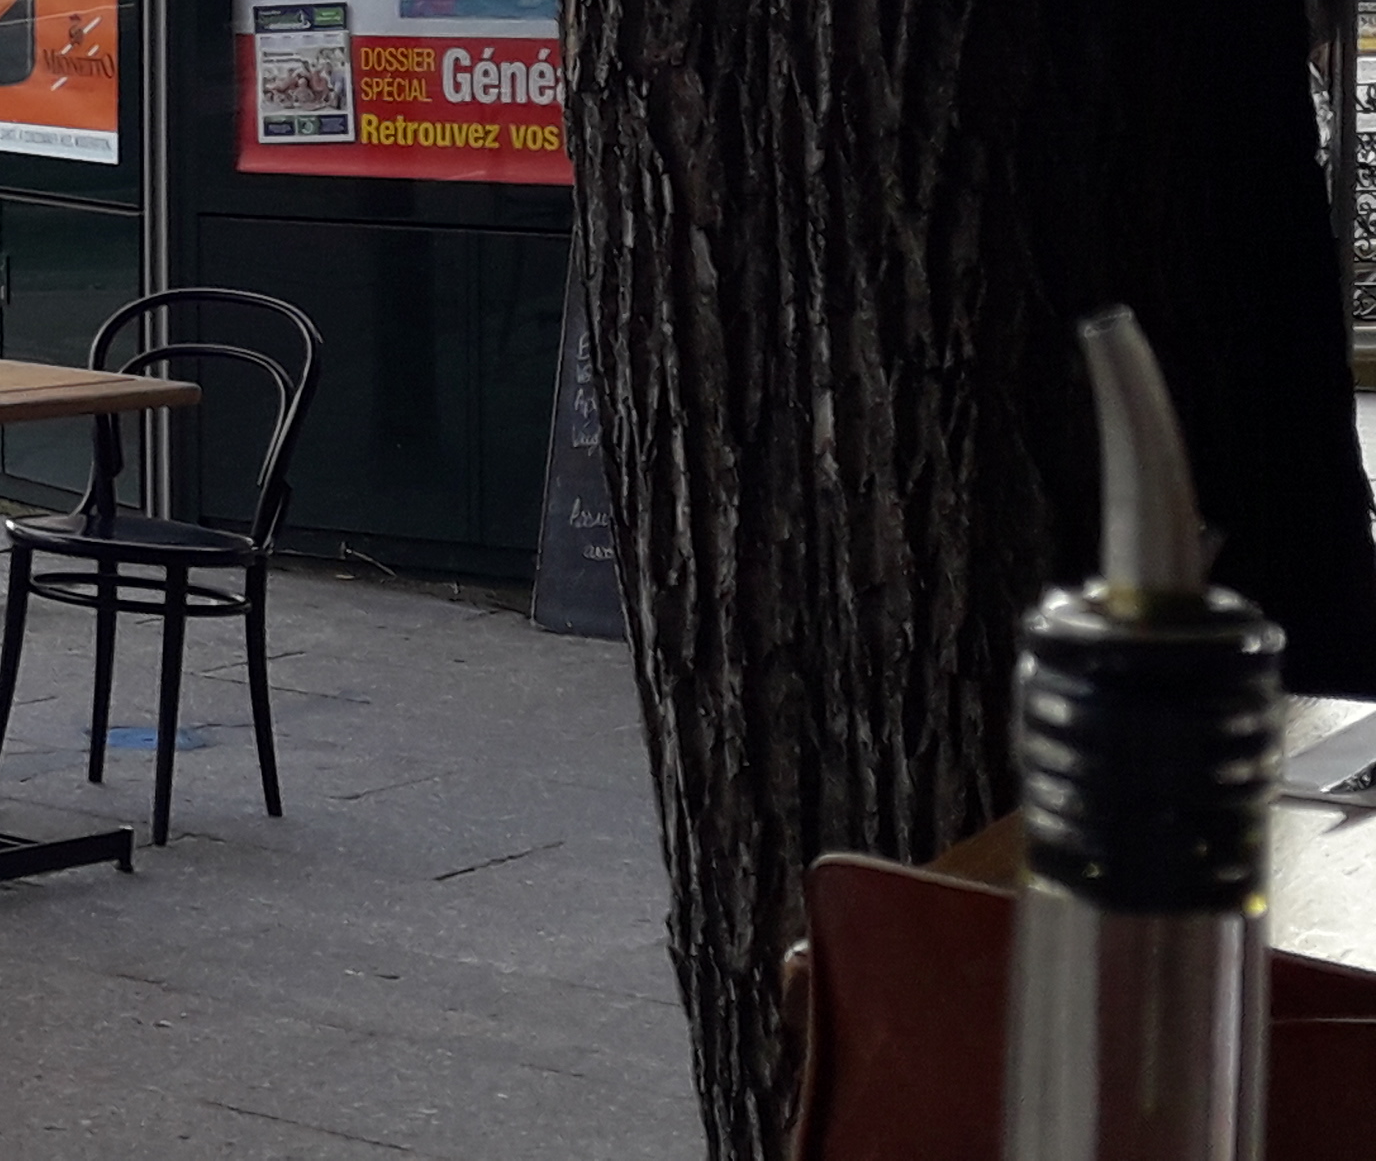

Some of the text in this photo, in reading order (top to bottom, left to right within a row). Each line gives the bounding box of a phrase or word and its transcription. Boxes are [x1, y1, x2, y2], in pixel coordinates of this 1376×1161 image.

[360, 47, 435, 72] DOSSIER
[360, 73, 432, 102] SPÉCIAL
[360, 113, 500, 150] Retrouvez
[510, 123, 560, 152] vos
